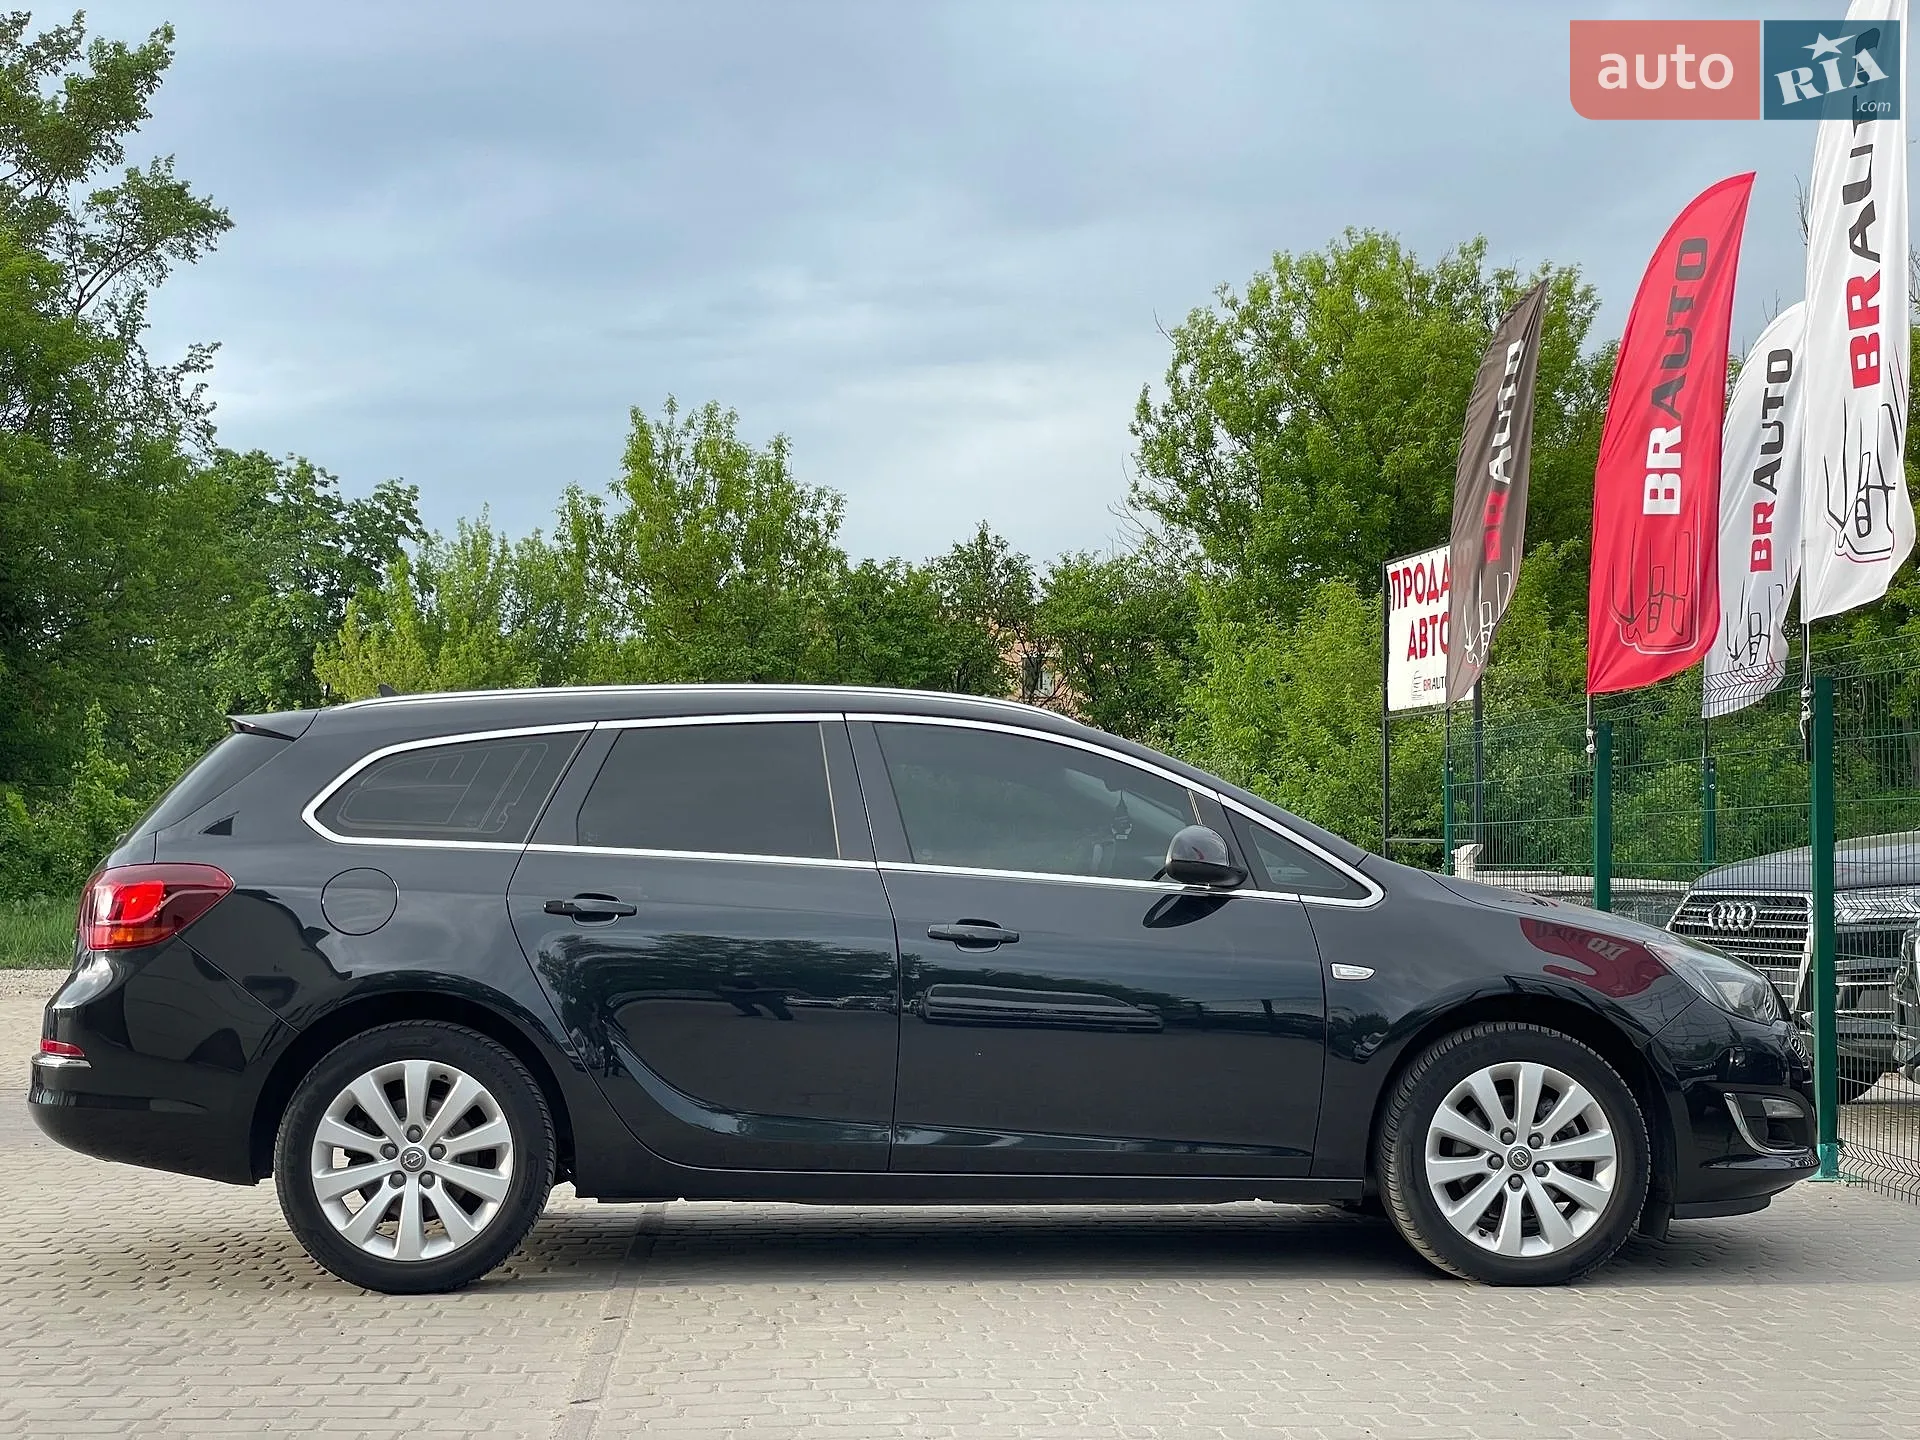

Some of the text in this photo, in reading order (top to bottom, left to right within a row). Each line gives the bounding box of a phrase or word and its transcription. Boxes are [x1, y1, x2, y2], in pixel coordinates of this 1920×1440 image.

[1643, 237, 1708, 515] BRAUTO
[1750, 348, 1793, 572] BRAUTO
[1390, 554, 1450, 611] ПРОДА
[1423, 676, 1447, 692] BRAUT
